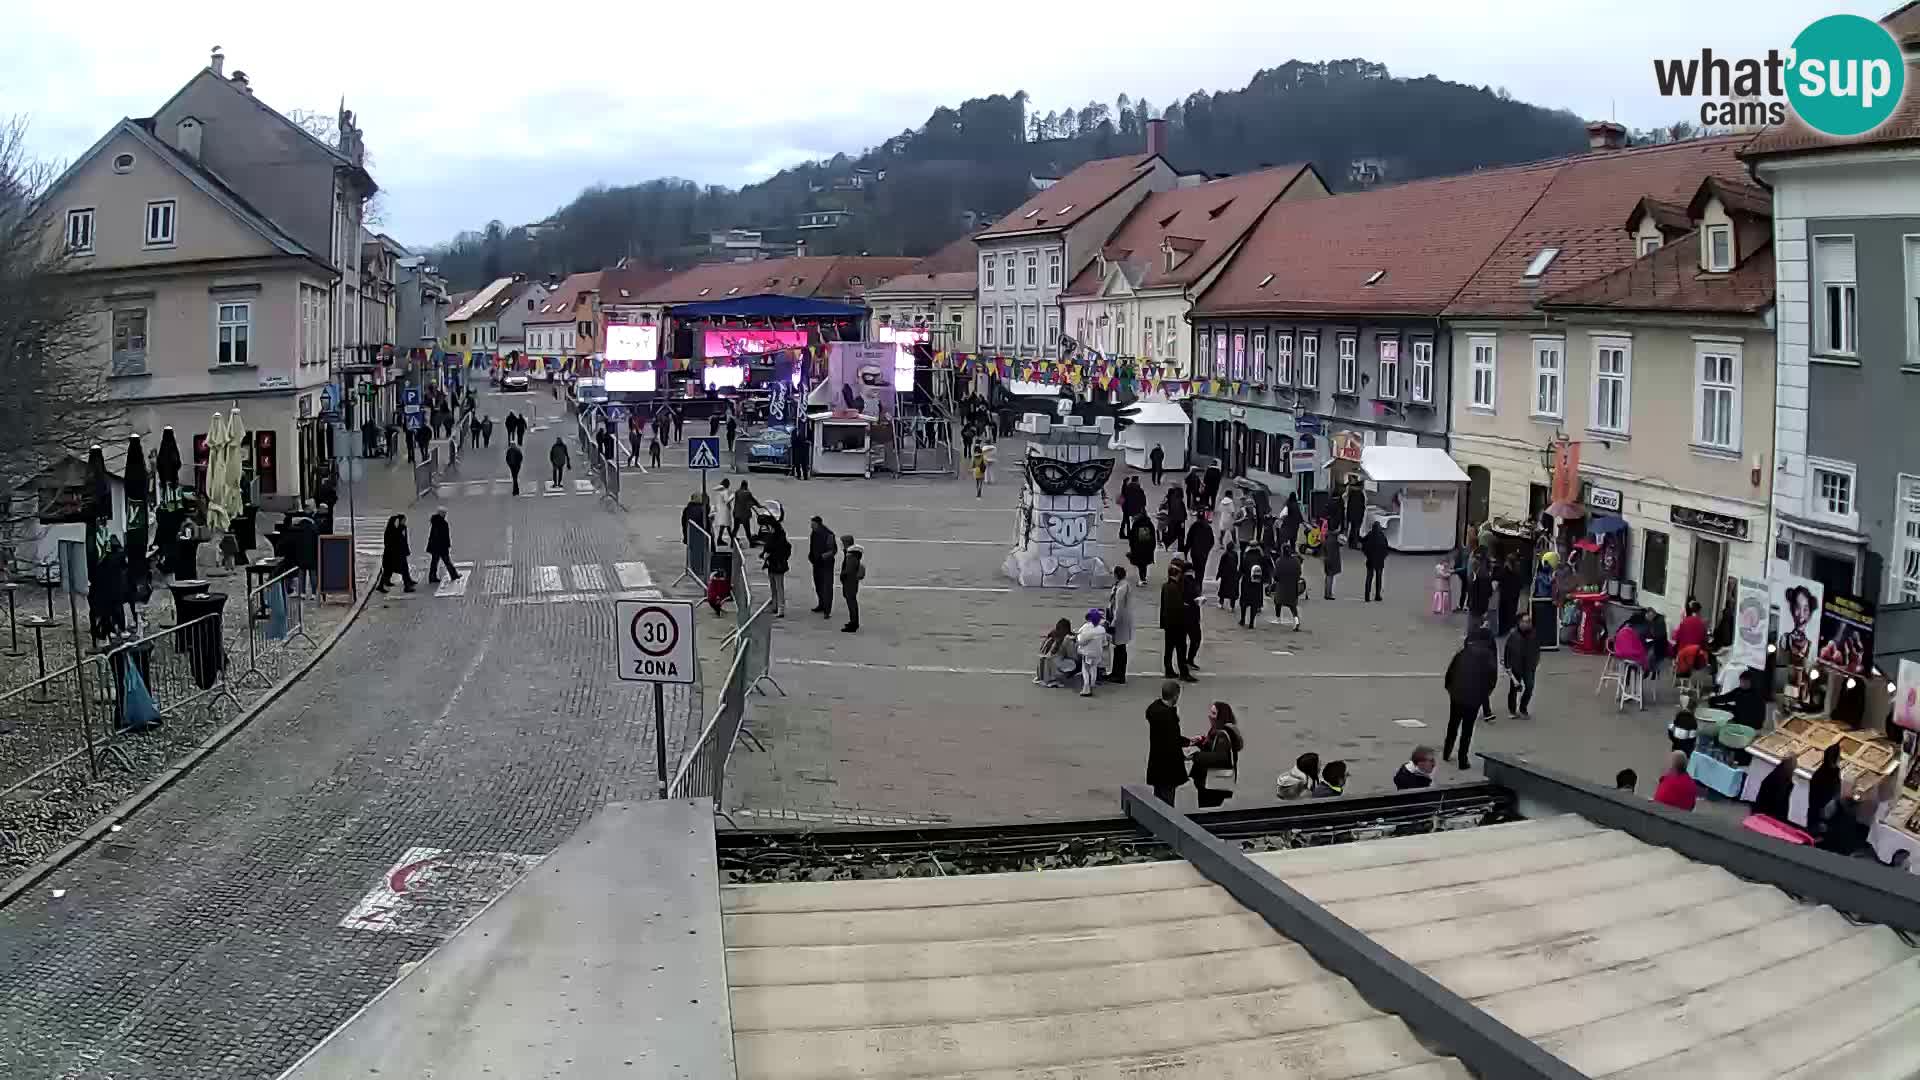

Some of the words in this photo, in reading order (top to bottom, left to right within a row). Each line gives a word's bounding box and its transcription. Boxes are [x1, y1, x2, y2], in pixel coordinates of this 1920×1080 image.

[408, 391, 416, 402] P
[1048, 517, 1087, 546] 200
[644, 622, 668, 643] 30
[633, 659, 678, 676] ZONA
